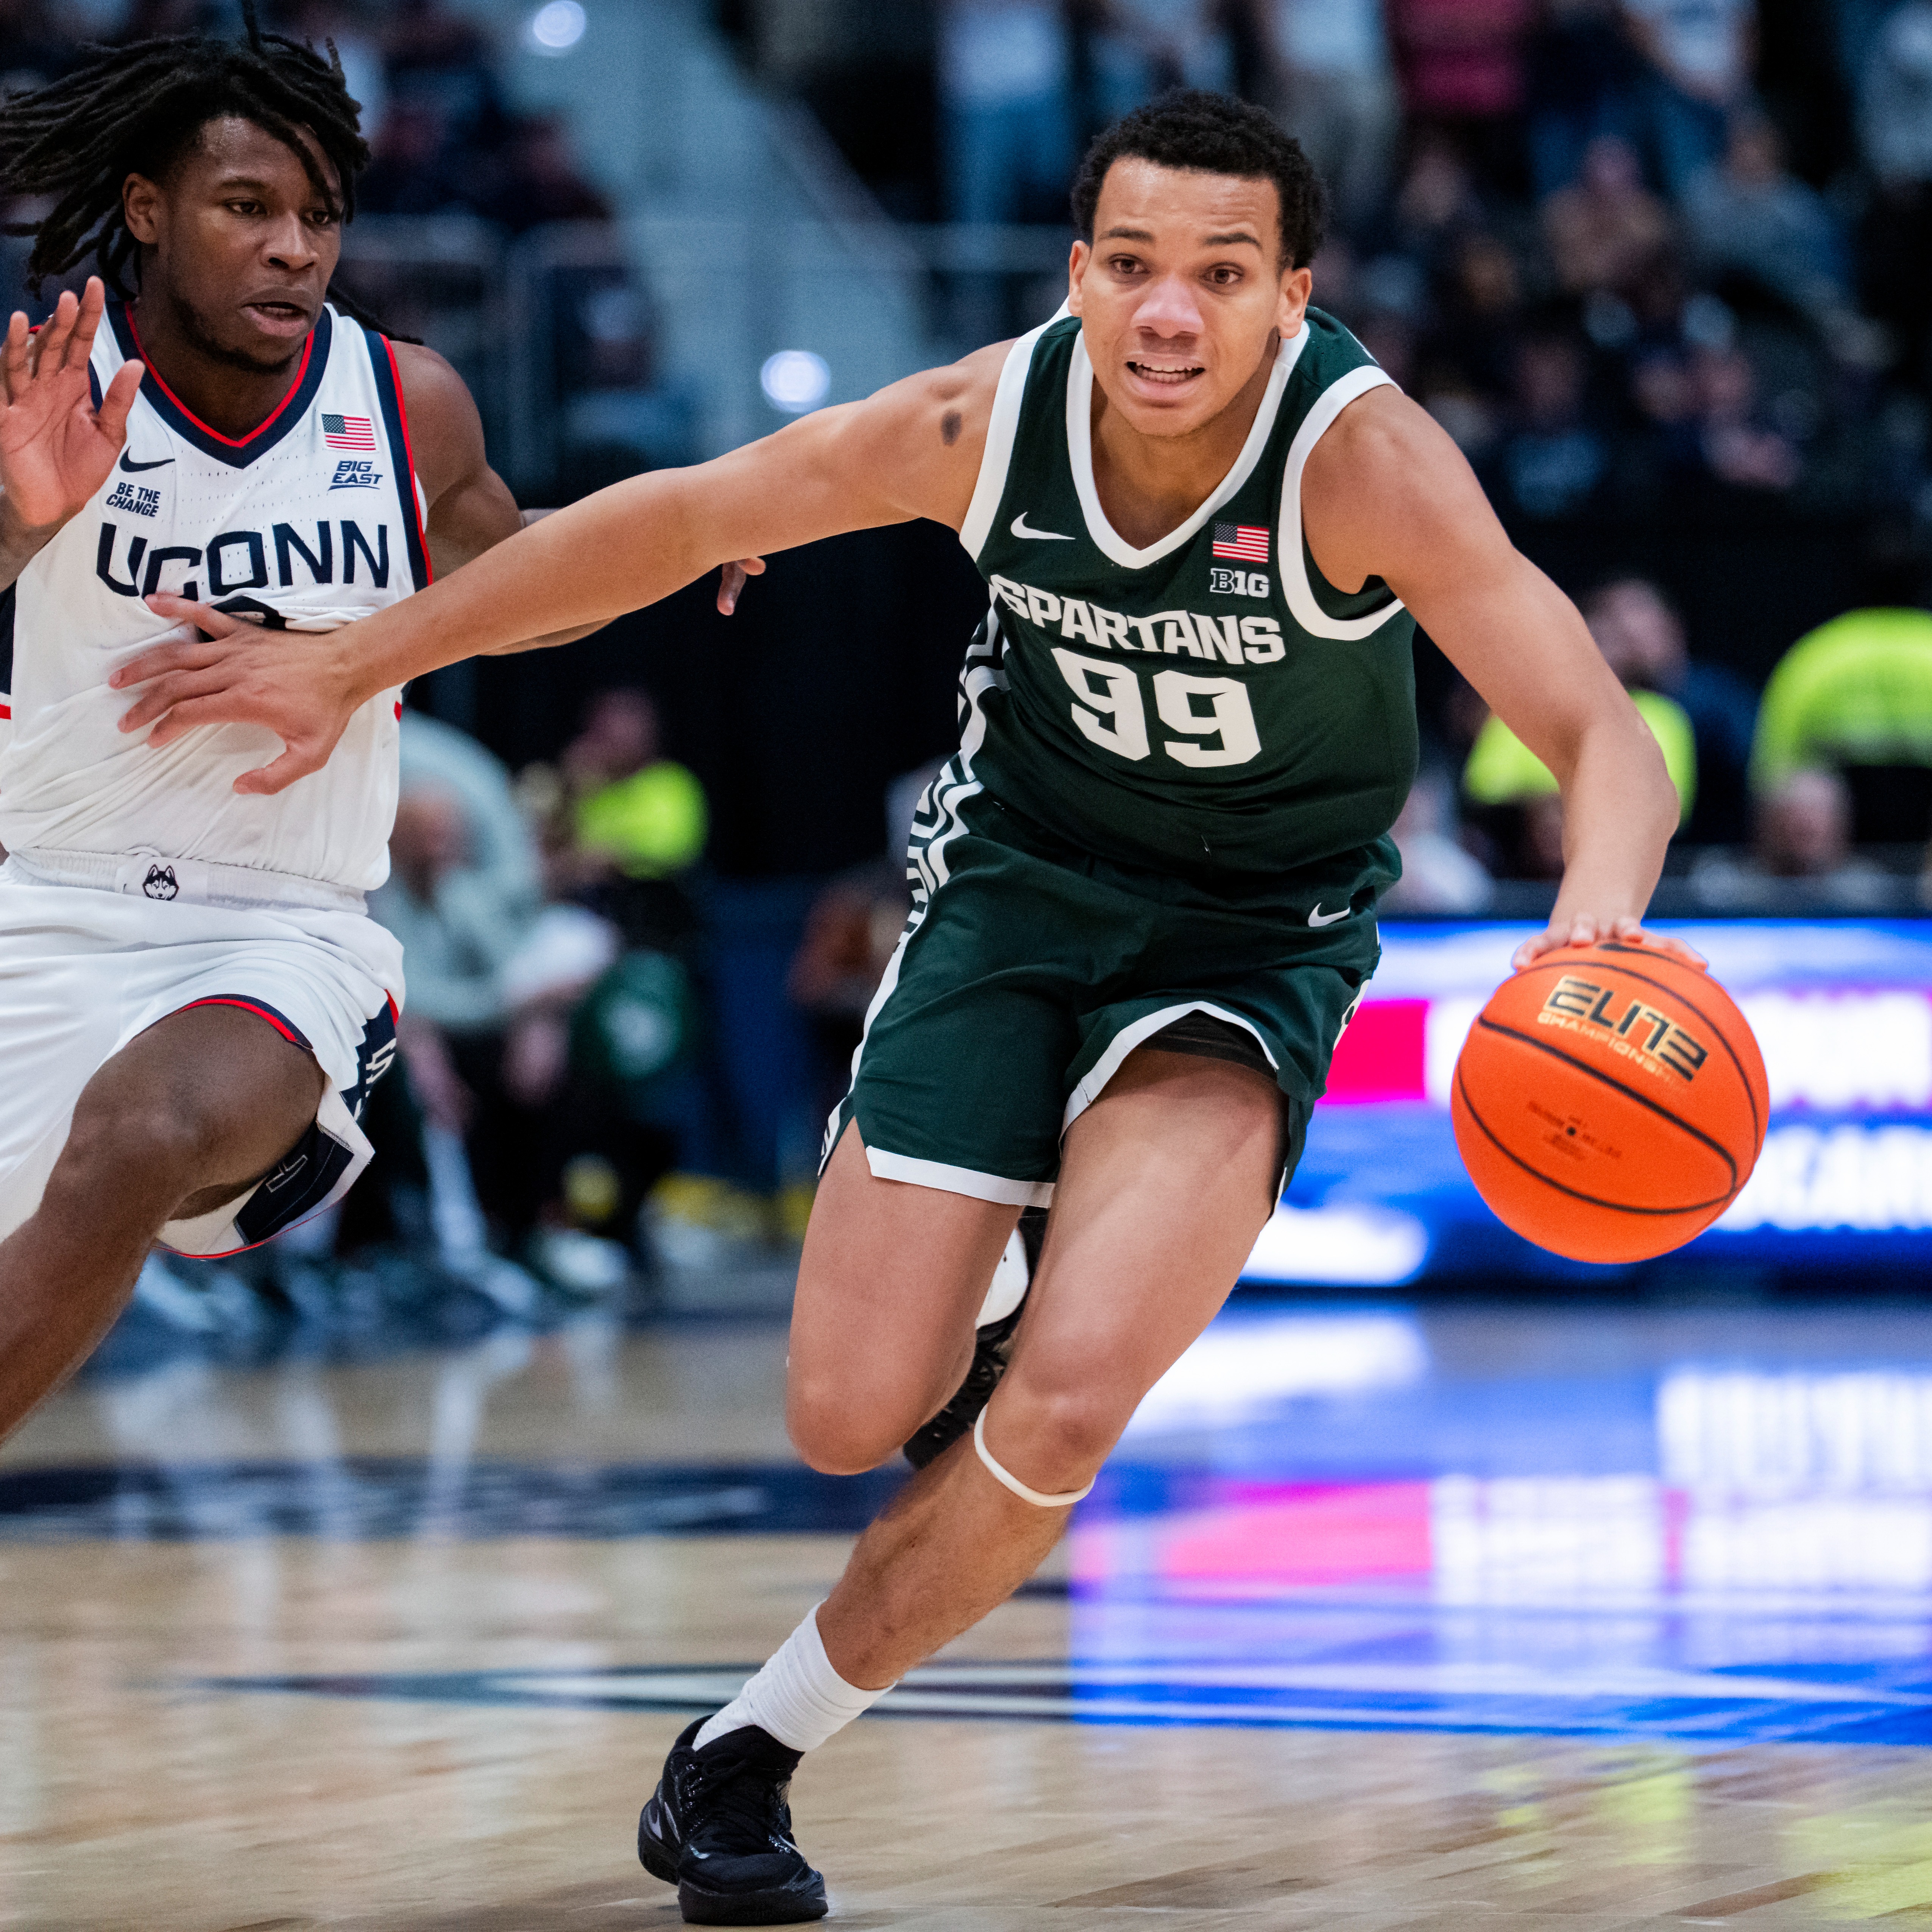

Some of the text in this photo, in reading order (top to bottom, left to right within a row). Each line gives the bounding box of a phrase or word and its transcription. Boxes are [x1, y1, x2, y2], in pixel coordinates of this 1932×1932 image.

[116, 482, 161, 503] BE THE
[332, 473, 383, 484] EAST
[336, 461, 373, 472] BIG
[106, 494, 159, 517] CHANGE
[96, 520, 388, 601] UCONN
[990, 574, 1286, 664] SPARTANS
[1051, 648, 1261, 767] 99
[1542, 974, 1708, 1082] ELITE
